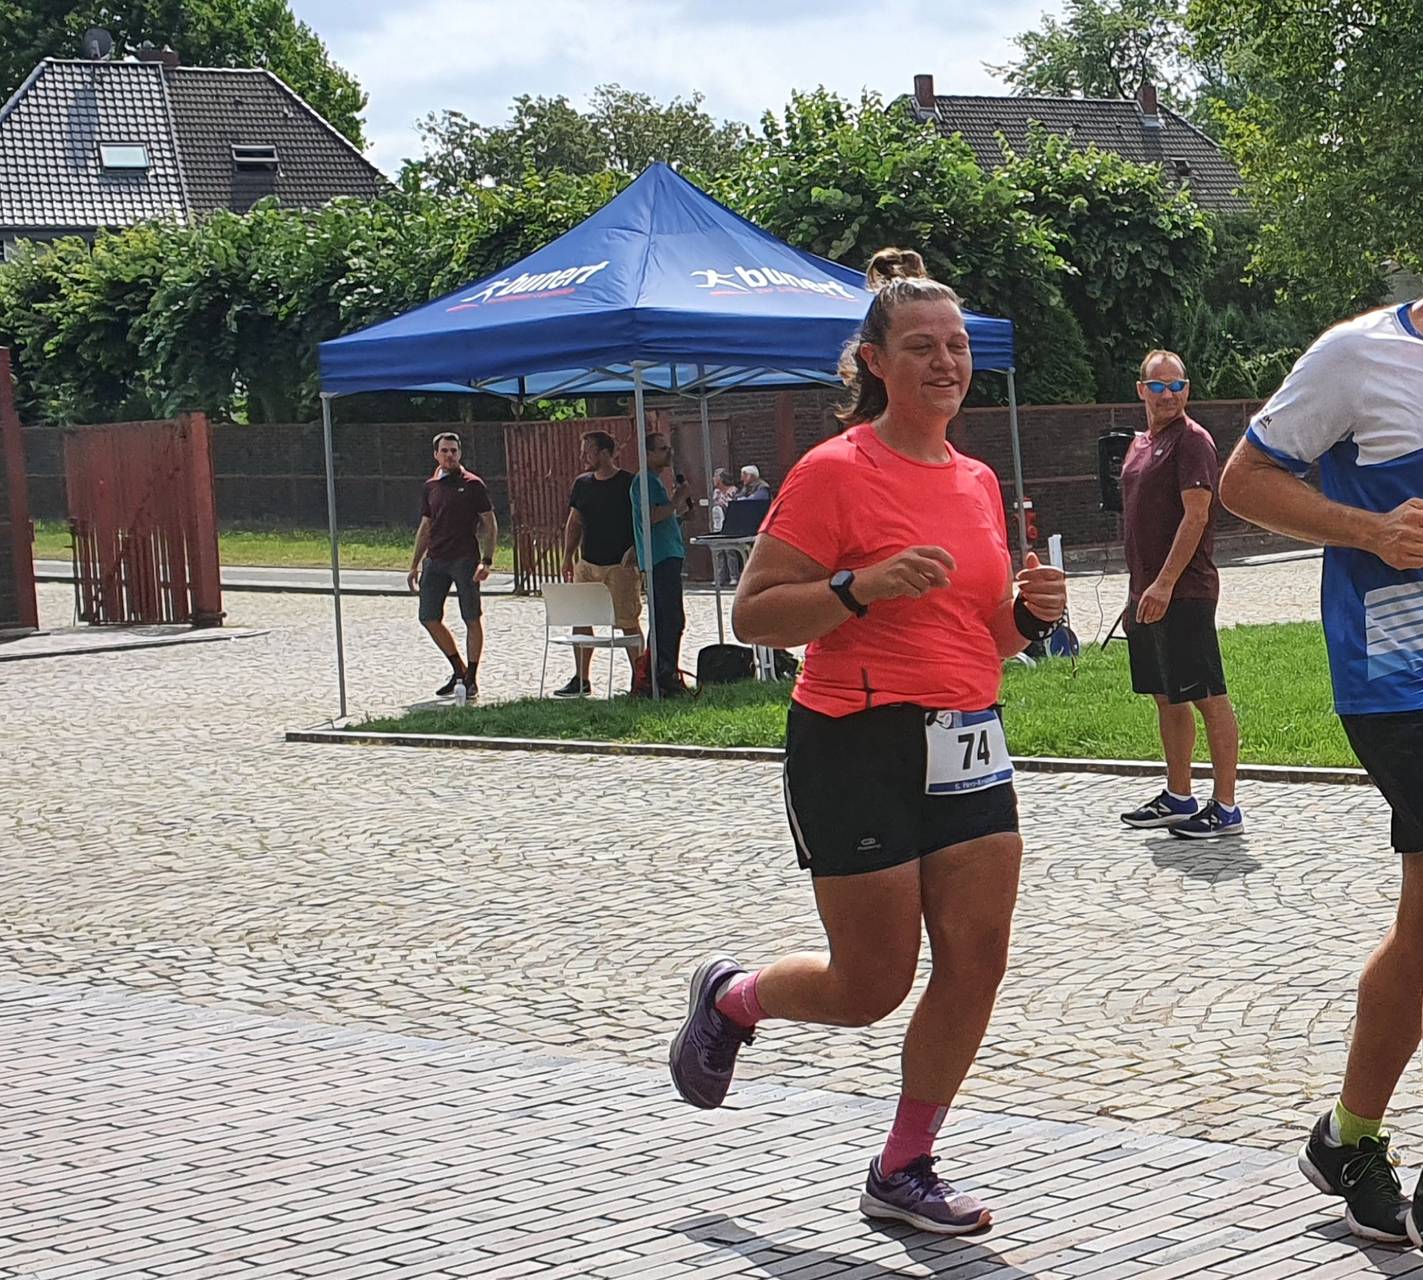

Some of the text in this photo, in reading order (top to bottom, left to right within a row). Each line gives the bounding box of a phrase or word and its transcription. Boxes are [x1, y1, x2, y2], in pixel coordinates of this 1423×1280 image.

[495, 260, 611, 297] bunert
[734, 265, 855, 299] bunert
[957, 729, 991, 771] 74
